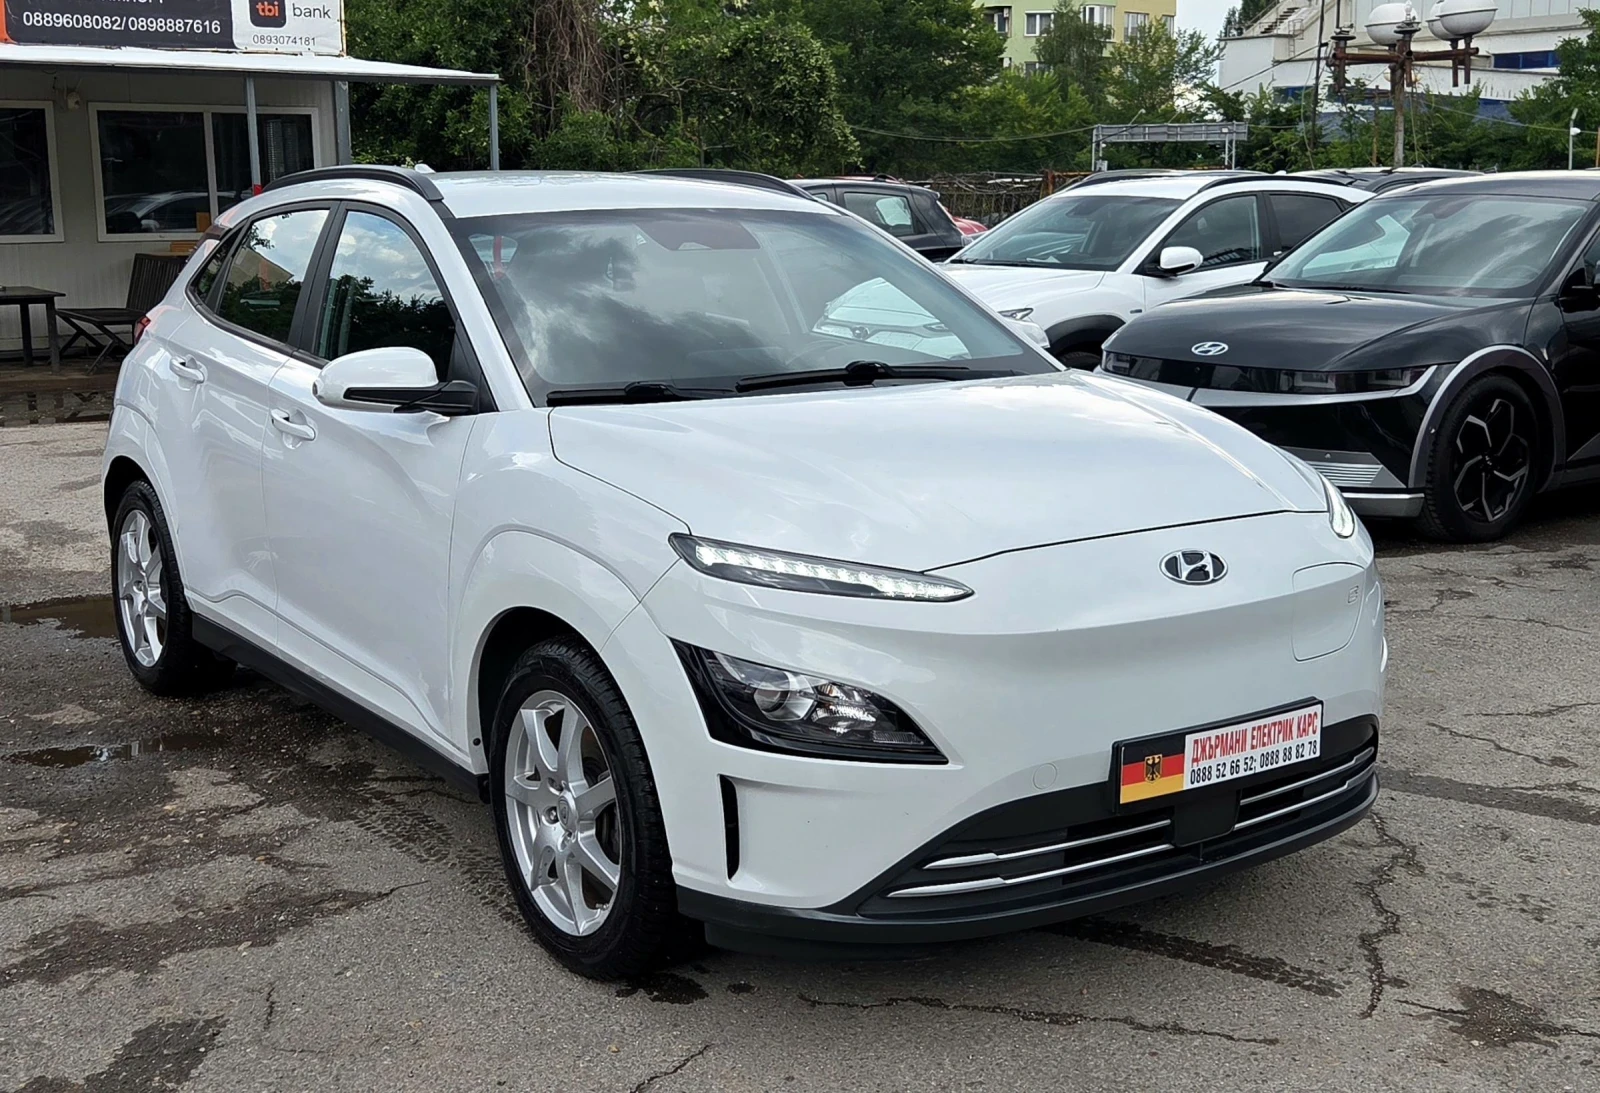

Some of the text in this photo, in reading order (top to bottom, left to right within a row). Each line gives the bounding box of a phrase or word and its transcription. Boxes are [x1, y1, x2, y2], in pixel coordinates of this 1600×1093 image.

[256, 1, 331, 19] tbi bank
[252, 34, 316, 46] 0893074181
[1191, 711, 1318, 768] ДЖЪРМАНИ ЕЛЕКТРИК КАРС
[1190, 740, 1317, 785] 0888 52 66 52; 0888 88 82 78
